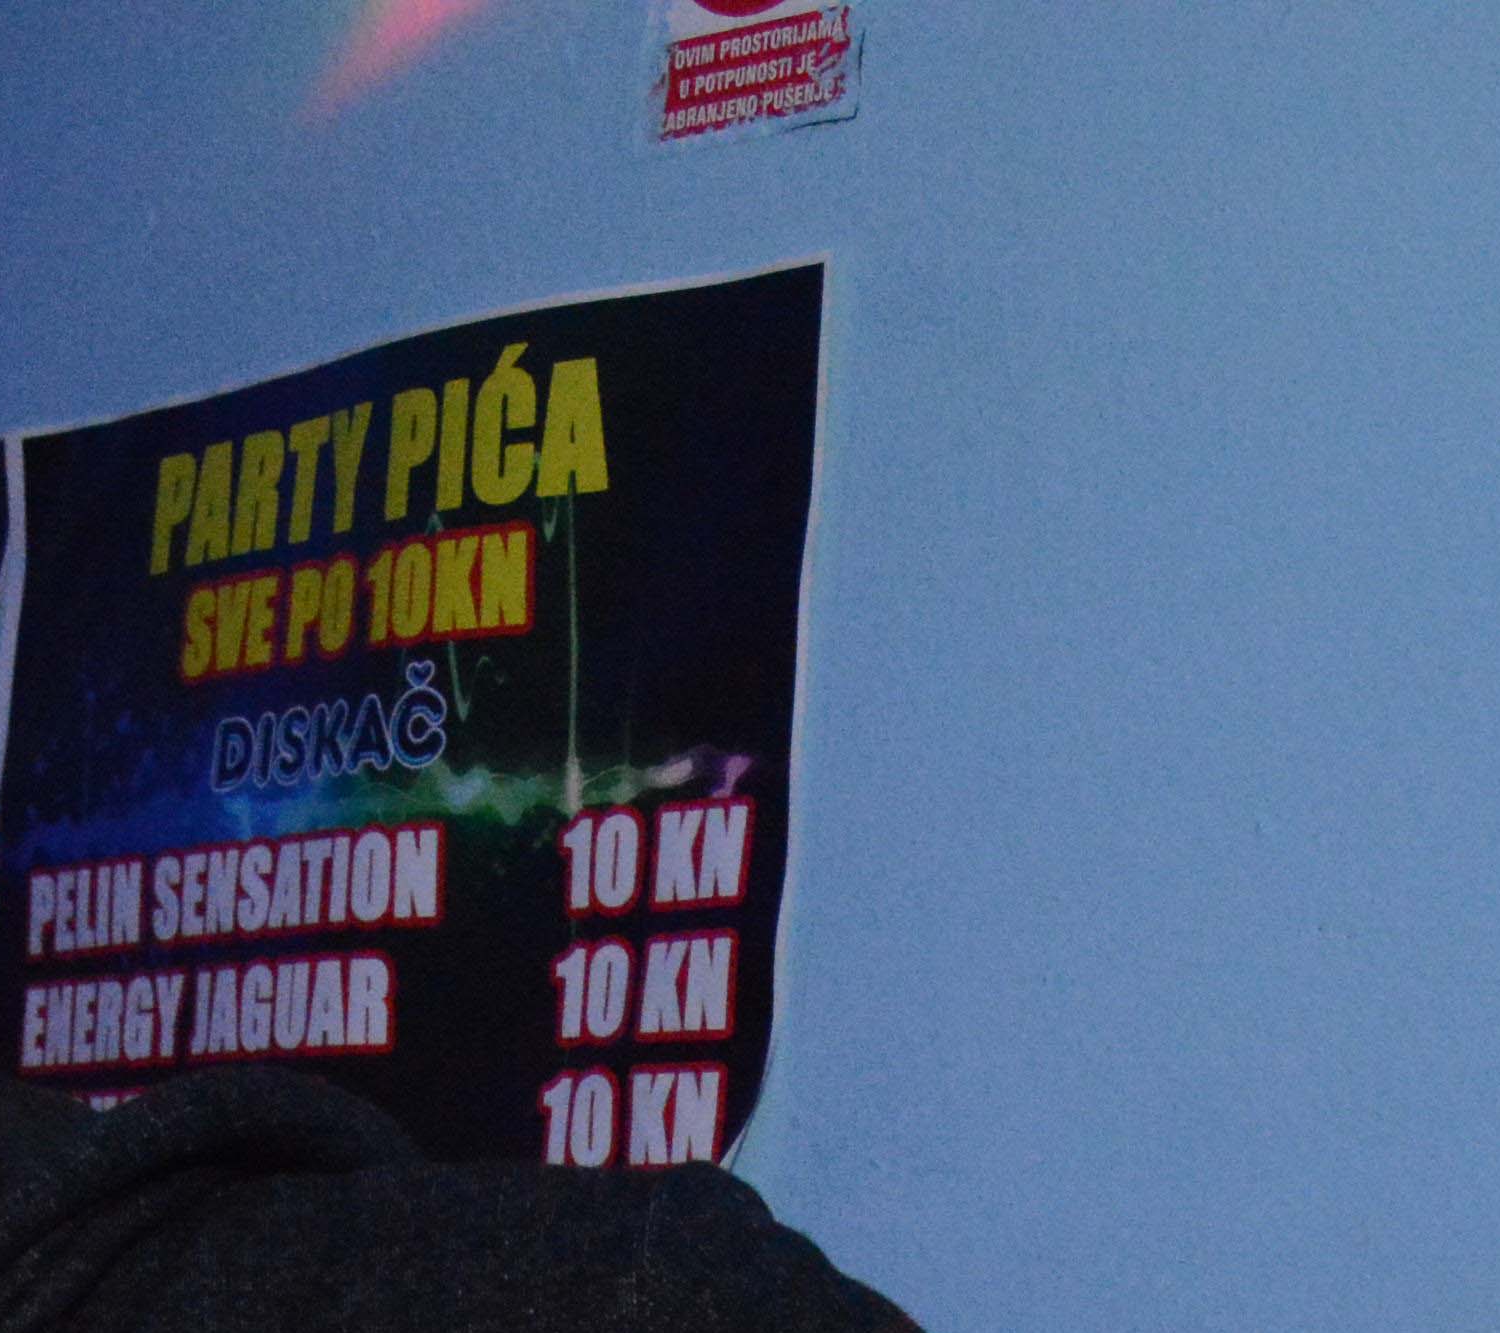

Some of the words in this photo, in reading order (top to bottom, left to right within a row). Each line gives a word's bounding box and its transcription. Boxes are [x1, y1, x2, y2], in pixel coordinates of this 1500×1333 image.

[675, 43, 715, 70] OVIM
[719, 16, 846, 61] PROSTORIJAMA
[679, 79, 689, 99] U
[694, 57, 793, 96] POTPUNOSTI
[797, 51, 817, 74] JE
[664, 95, 758, 132] ABRANJENO
[150, 401, 373, 576] PARTY
[384, 341, 609, 522] PIĆA
[183, 576, 279, 679] SVE
[286, 559, 356, 659] PO
[368, 530, 528, 643] 10KN
[210, 660, 447, 793] DISKAČ
[29, 861, 142, 956] PELIN
[153, 829, 439, 941] SENSATION
[563, 813, 639, 909] 10
[655, 805, 749, 902] KN
[21, 973, 185, 1068] ENERGY
[190, 957, 389, 1055] JAGUAR
[556, 944, 629, 1038] 10
[640, 936, 732, 1034] KN
[543, 1073, 614, 1168] 10
[629, 1071, 720, 1166] KN
